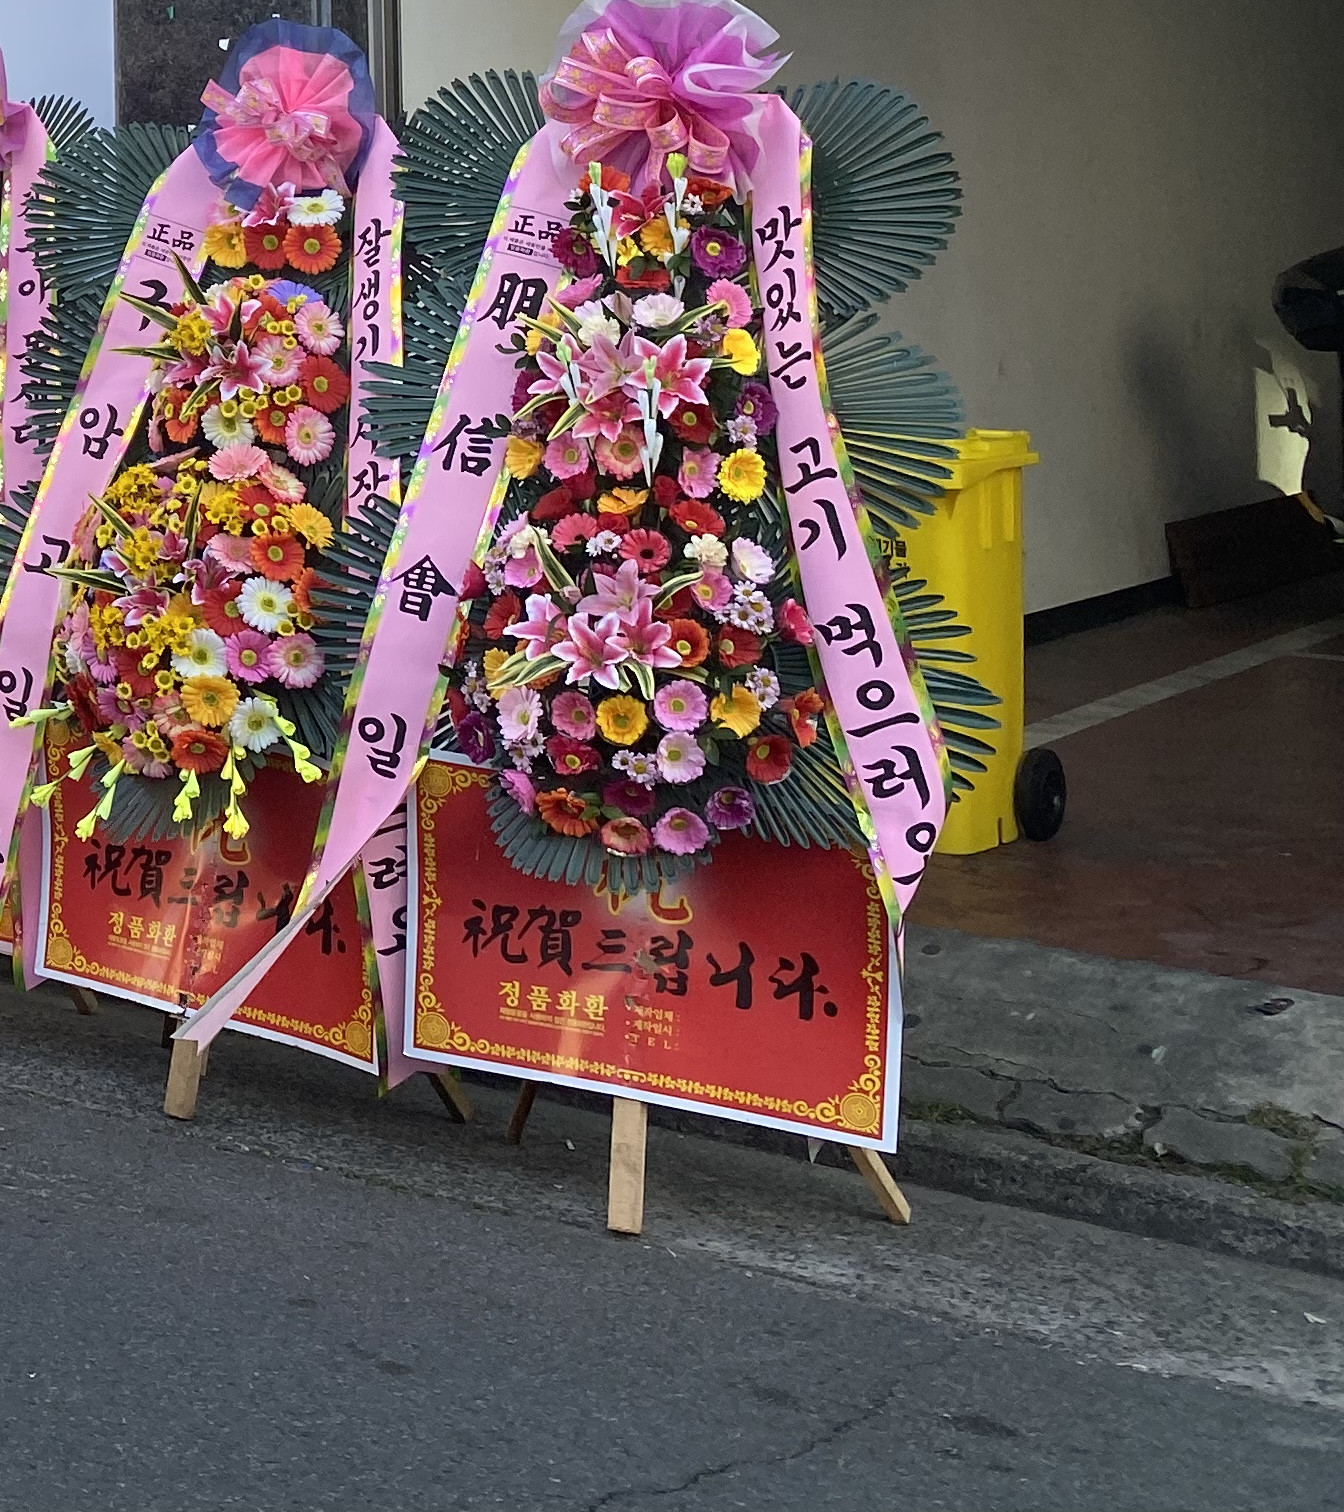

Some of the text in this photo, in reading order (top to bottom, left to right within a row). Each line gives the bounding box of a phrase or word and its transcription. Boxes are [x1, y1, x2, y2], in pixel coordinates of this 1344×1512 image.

[754, 204, 813, 391] 맛있는
[784, 435, 847, 562] 고기
[107, 911, 177, 948] 정품화환
[498, 980, 609, 1021] 정품화환
